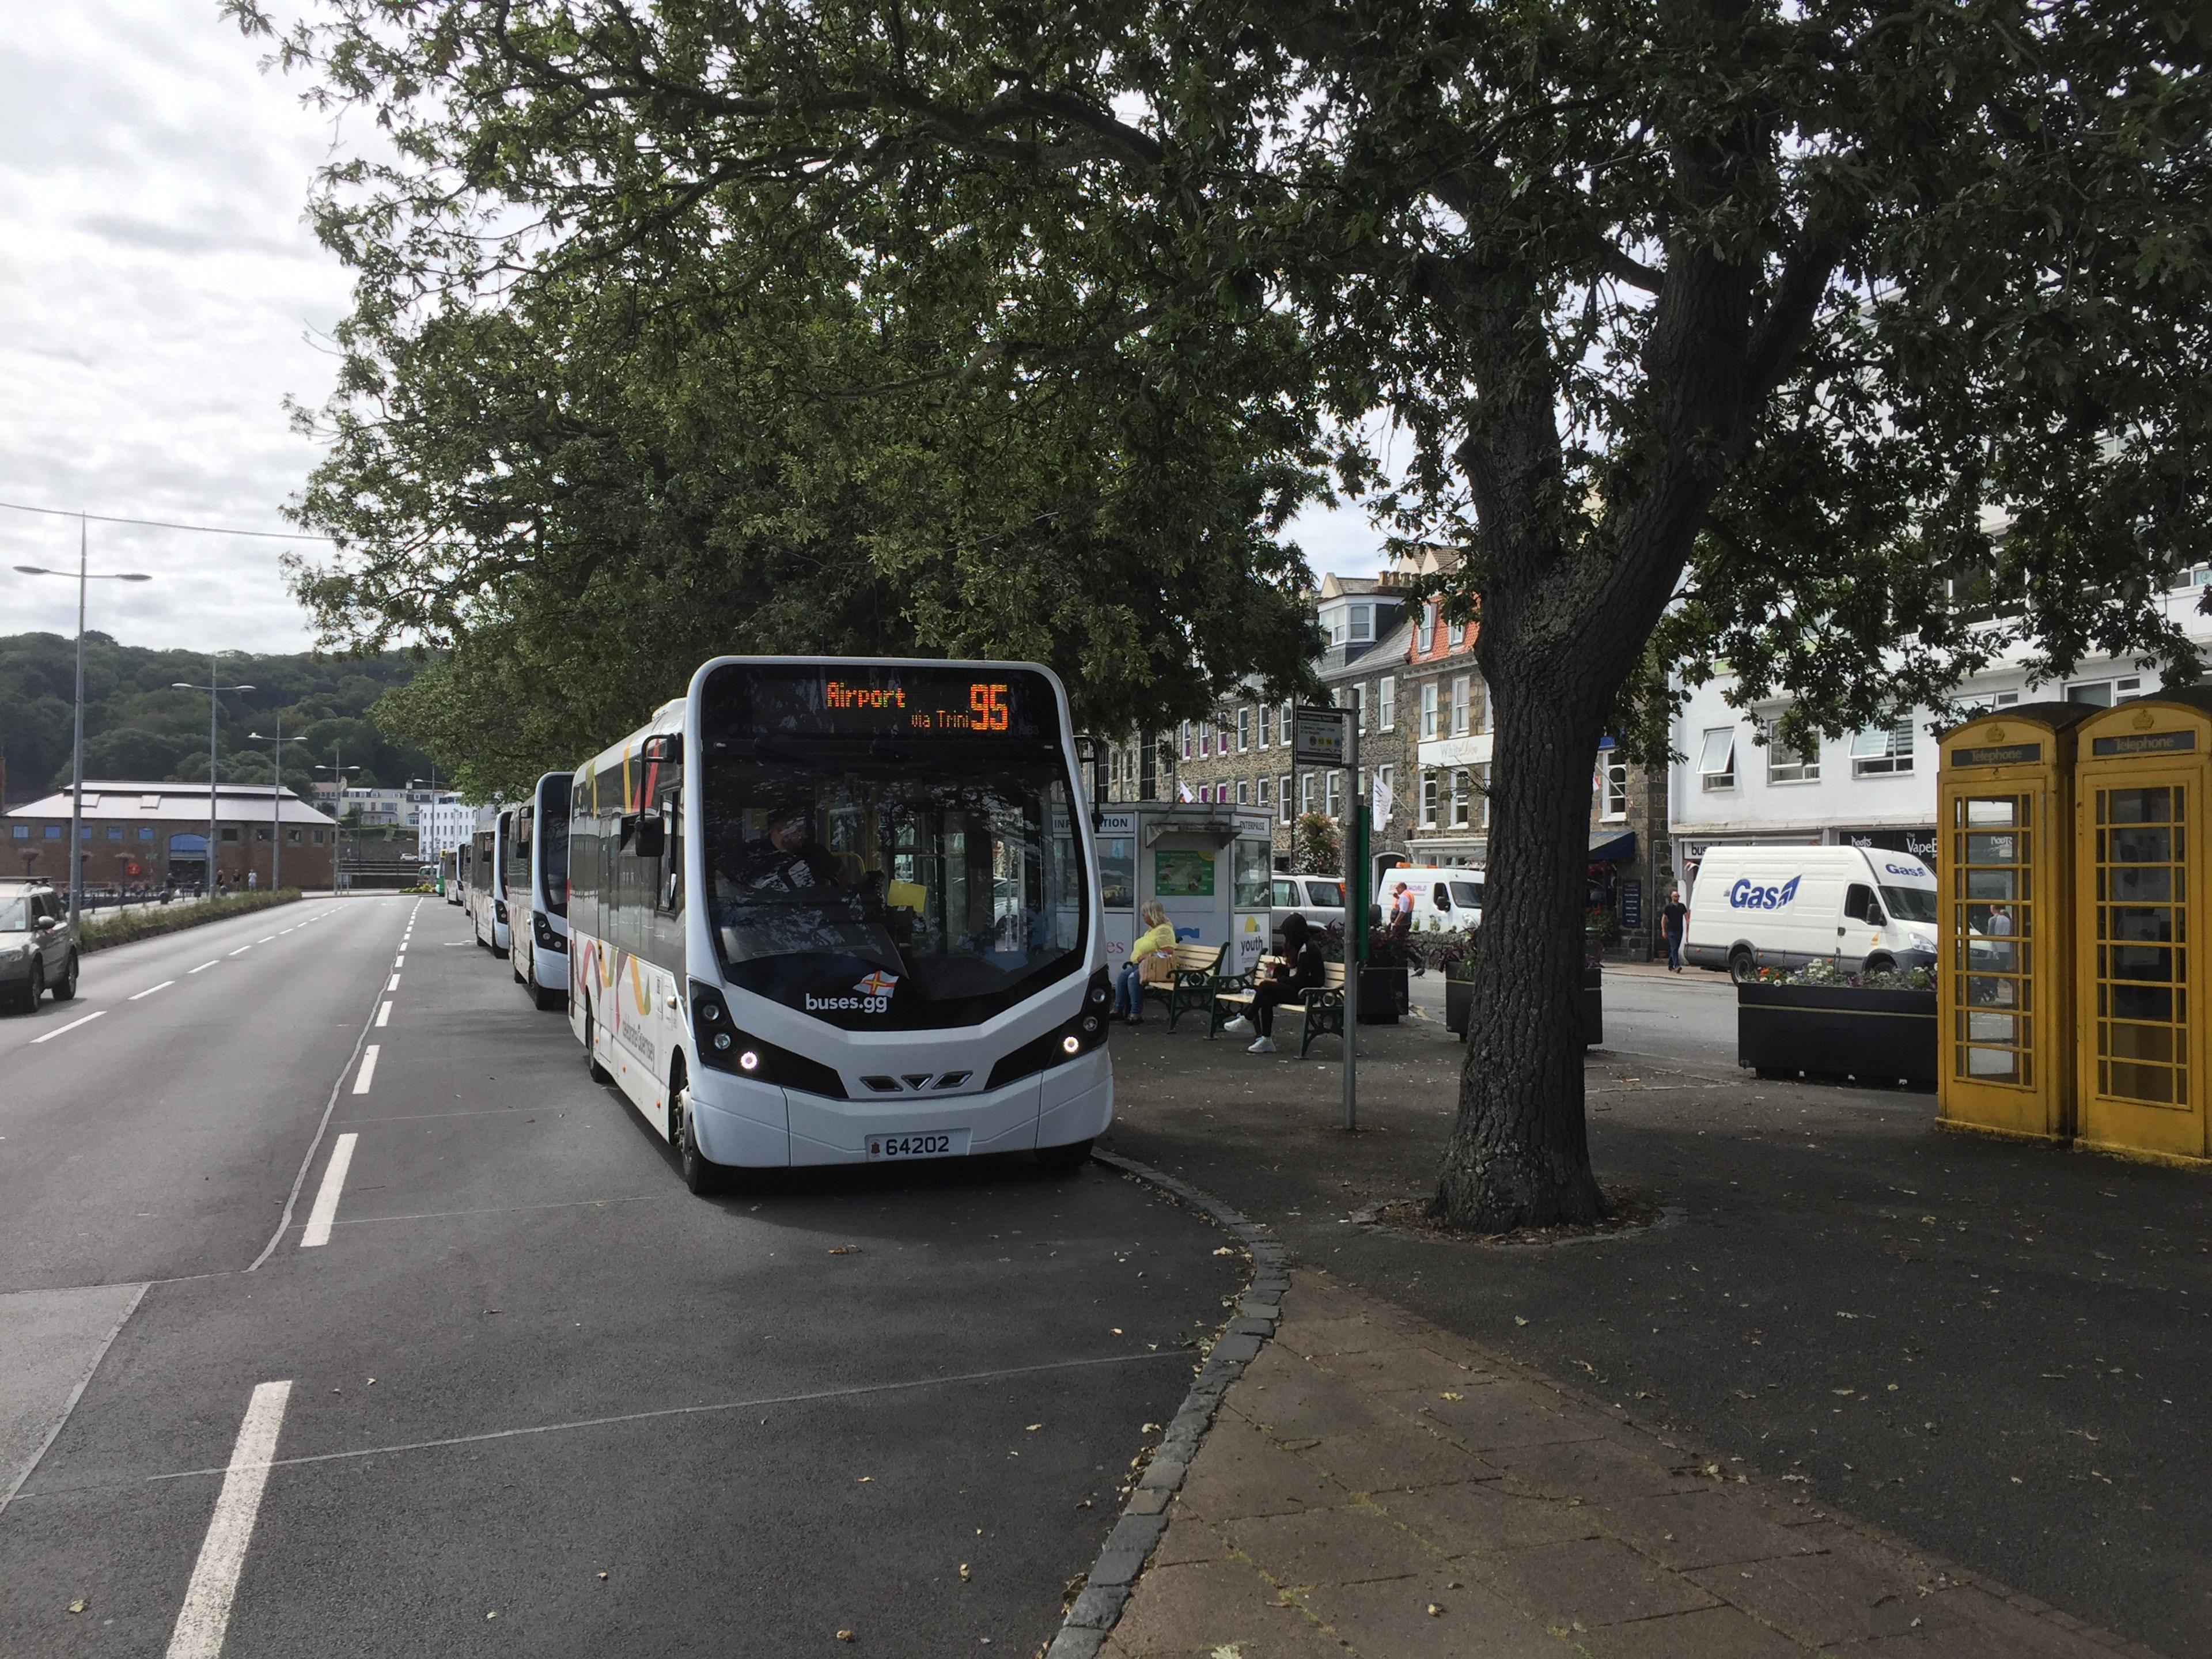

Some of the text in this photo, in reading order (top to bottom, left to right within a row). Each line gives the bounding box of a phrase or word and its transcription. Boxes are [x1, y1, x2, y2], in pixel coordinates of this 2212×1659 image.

[827, 682, 1007, 730] Airport 95
[911, 710, 930, 728] via
[2113, 736, 2175, 752] Telephone
[1972, 748, 2022, 763] Telephone
[1240, 821, 1264, 831] ENTERPRISE
[1885, 864, 1919, 876] Gas
[1730, 878, 1779, 910] Gas
[1240, 935, 1263, 956] youth
[806, 993, 887, 1013] buses.gg
[886, 1136, 949, 1156] 64202
